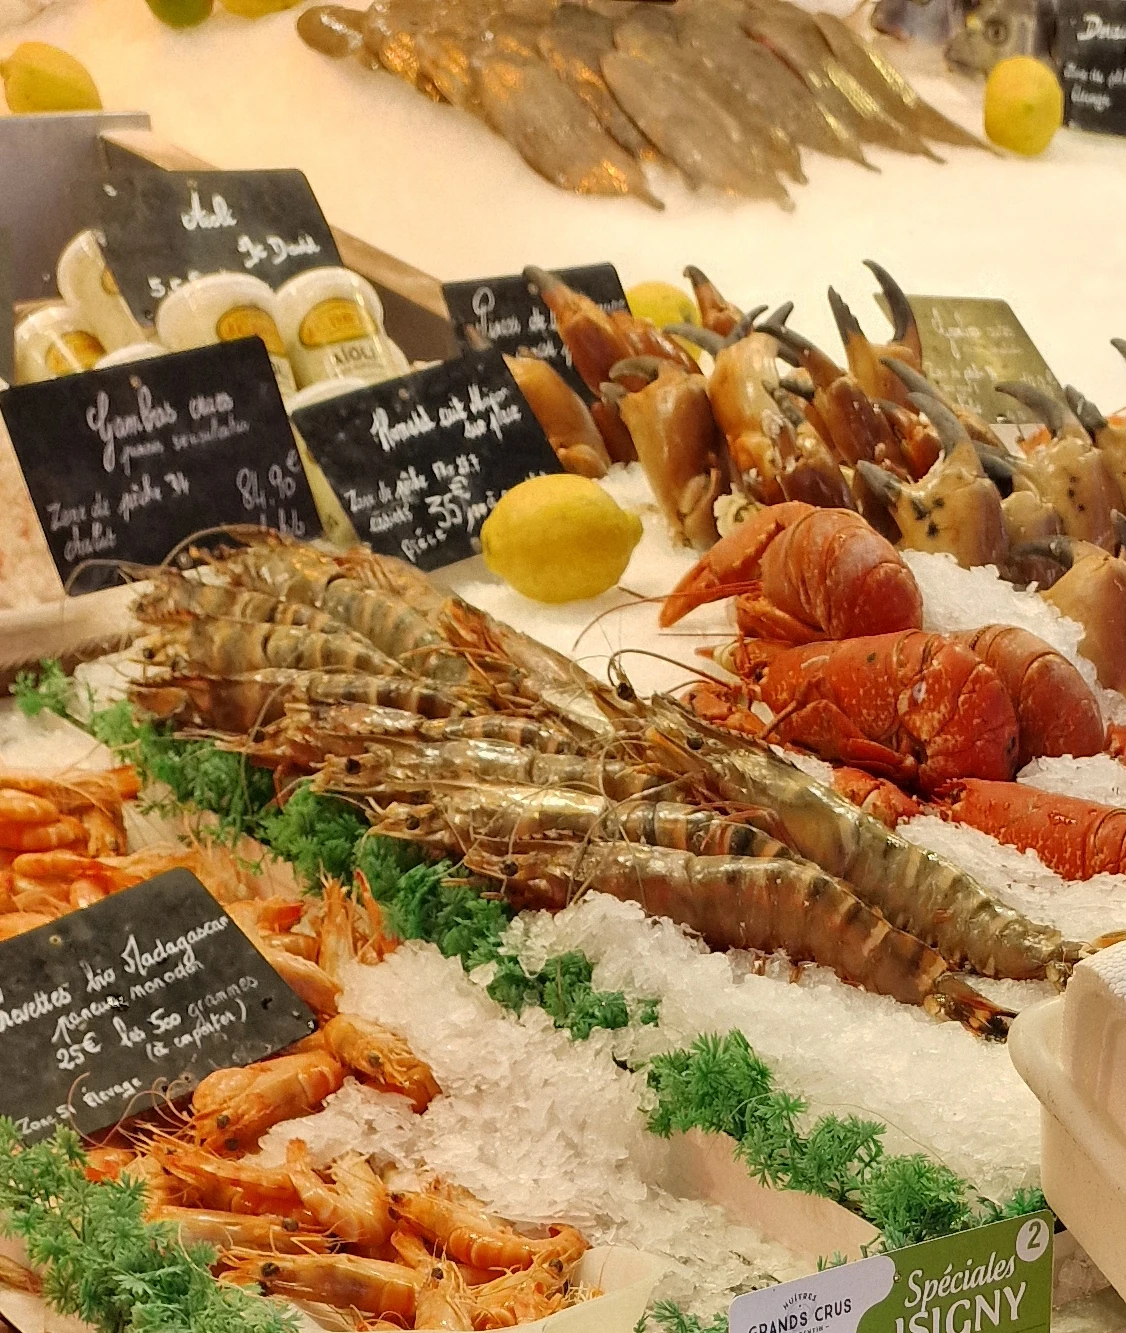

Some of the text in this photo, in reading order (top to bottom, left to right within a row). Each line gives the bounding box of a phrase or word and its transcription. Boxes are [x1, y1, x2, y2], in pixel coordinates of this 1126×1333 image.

[79, 956, 116, 993] bio
[121, 916, 230, 977] Madagascar
[147, 1007, 182, 1034] 500
[187, 975, 259, 1028] grammes
[1027, 1222, 1041, 1250] 2
[783, 1292, 817, 1310] HUÎTRES
[904, 1252, 1016, 1312] Spéciales
[814, 1298, 852, 1322] CRUS
